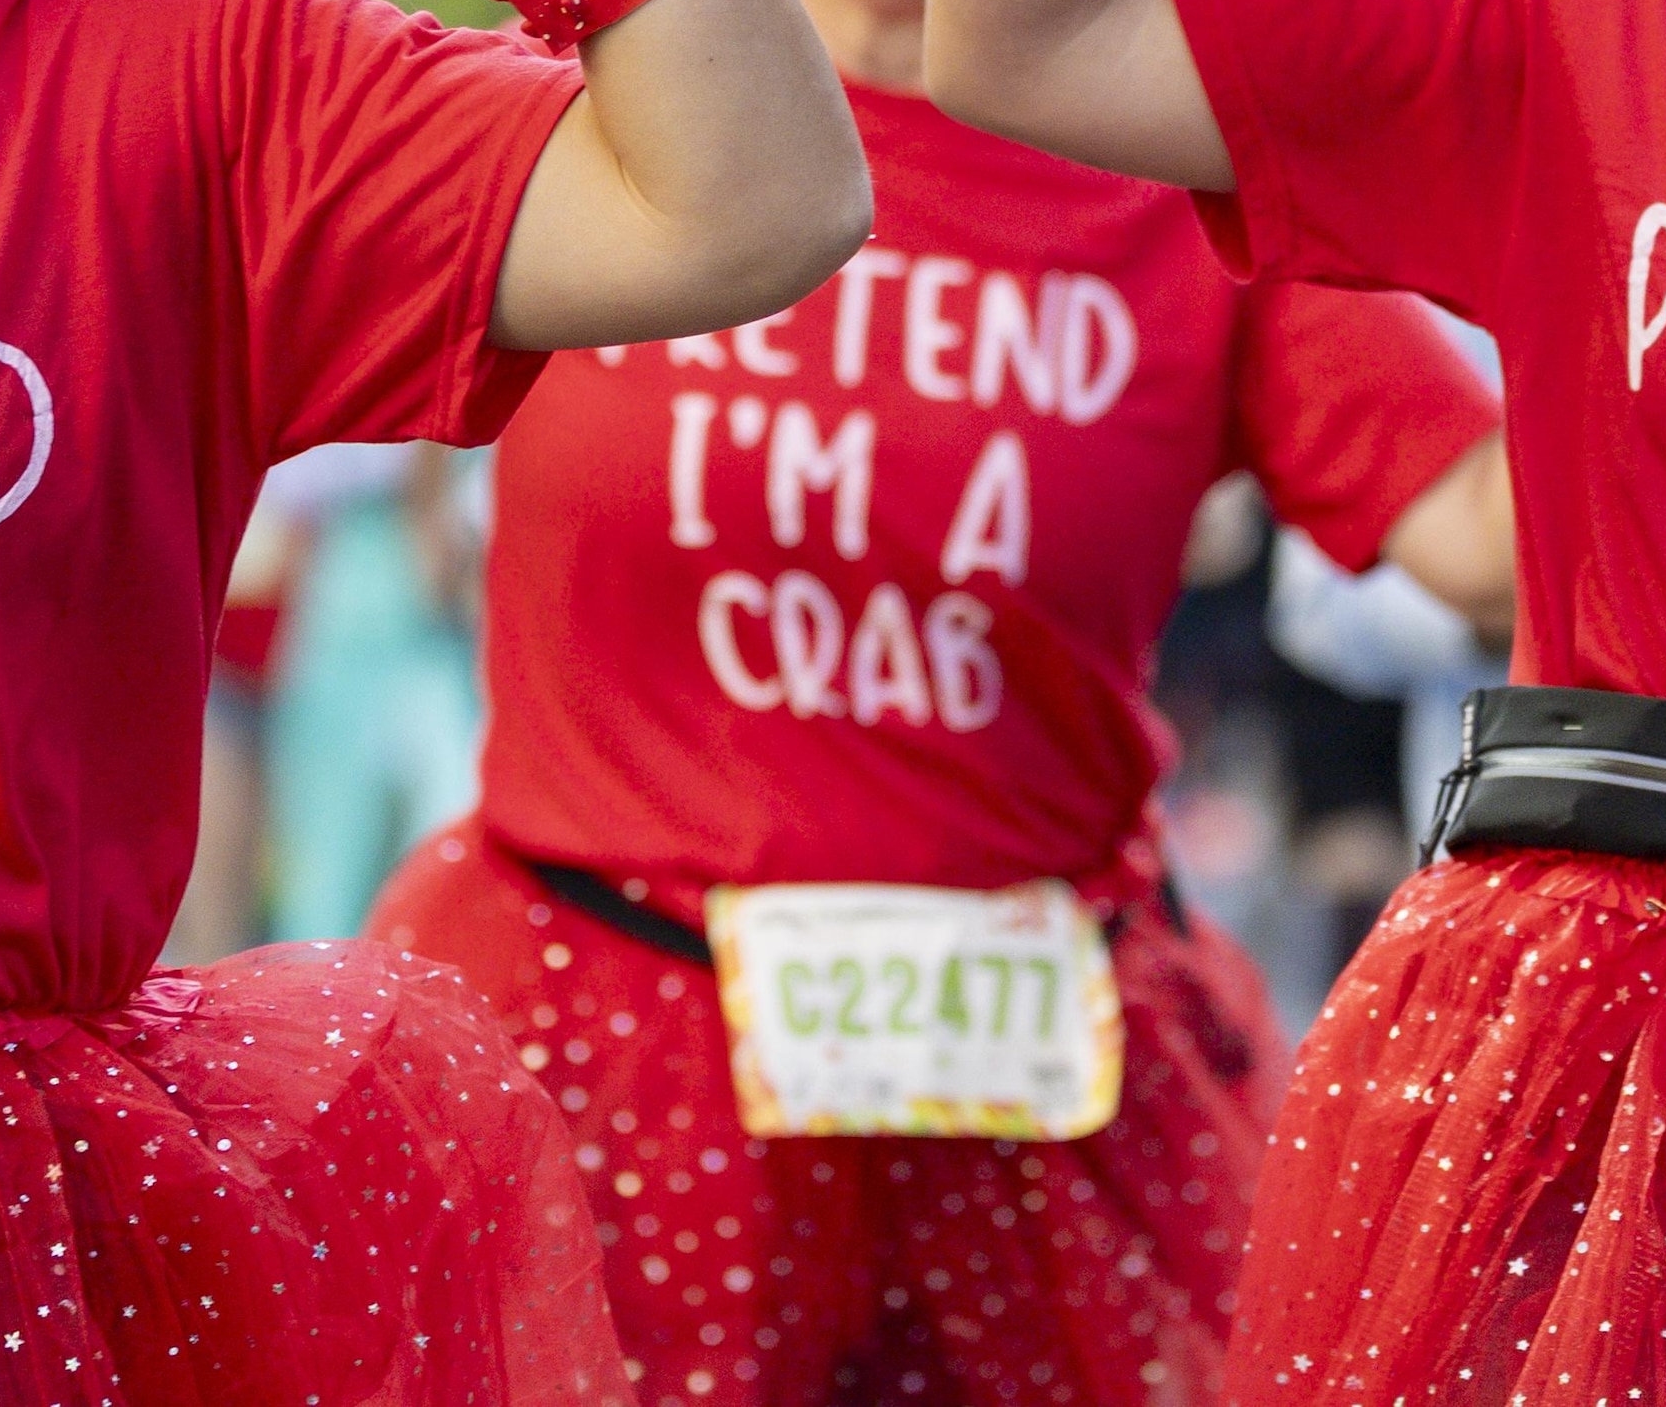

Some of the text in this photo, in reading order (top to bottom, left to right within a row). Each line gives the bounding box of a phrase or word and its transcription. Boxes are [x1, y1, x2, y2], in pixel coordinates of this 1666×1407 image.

[597, 247, 1138, 426] TEND
[668, 391, 1032, 588] I'M A
[698, 568, 1003, 734] CRAB
